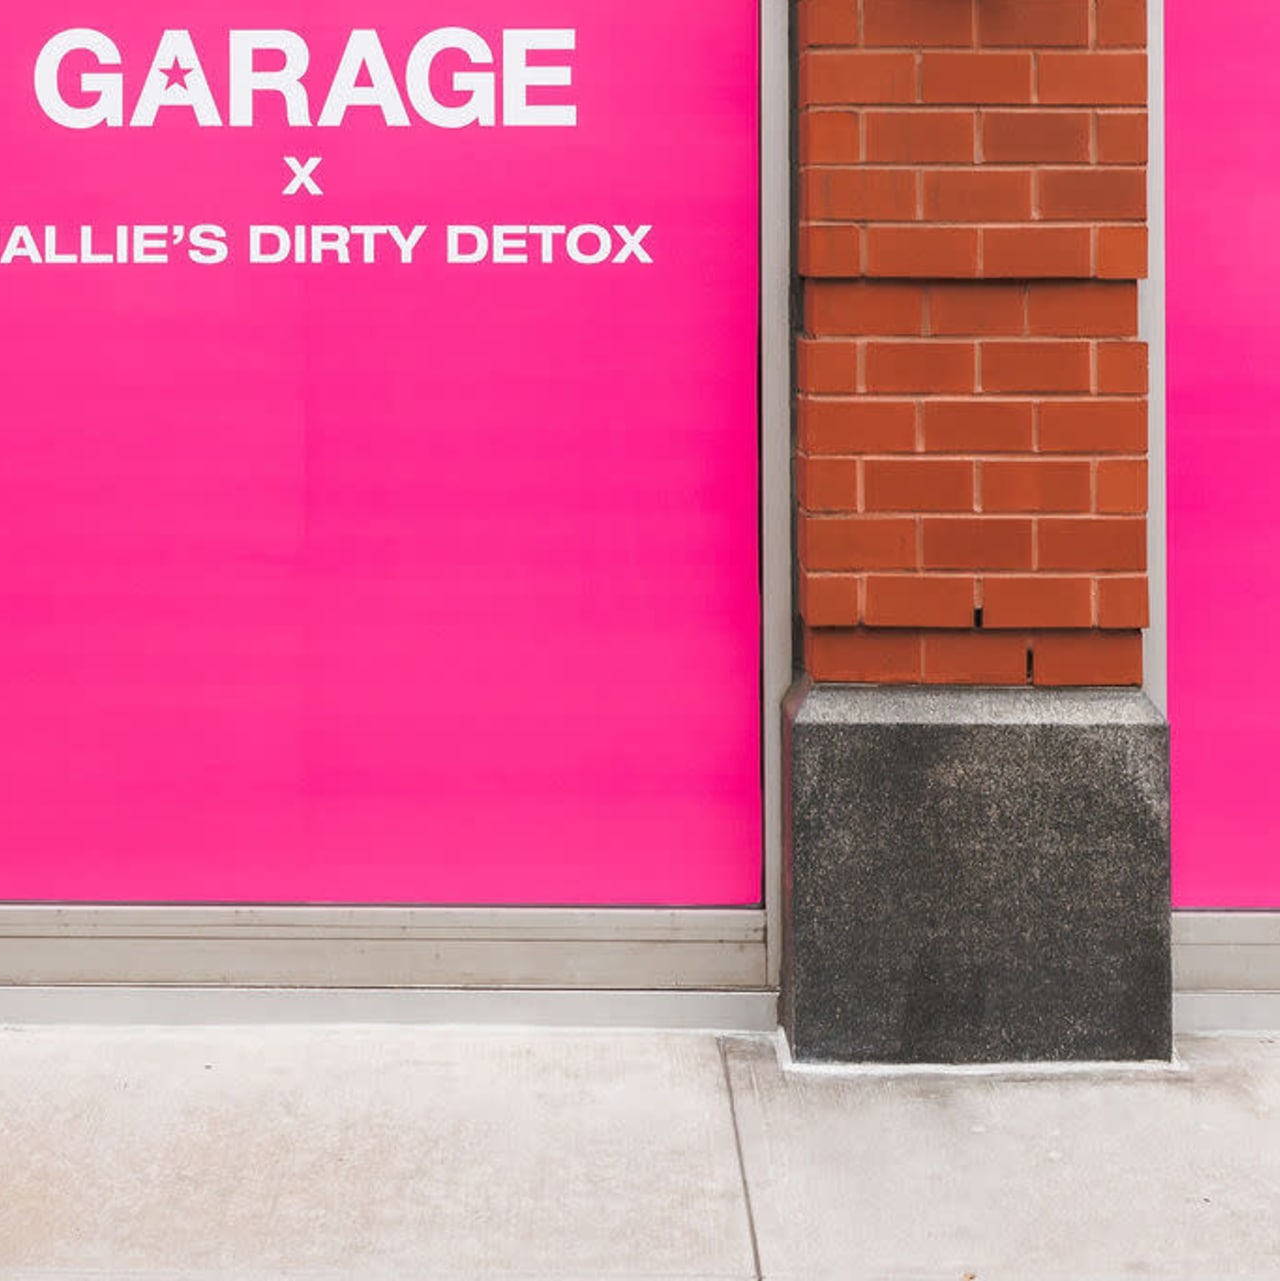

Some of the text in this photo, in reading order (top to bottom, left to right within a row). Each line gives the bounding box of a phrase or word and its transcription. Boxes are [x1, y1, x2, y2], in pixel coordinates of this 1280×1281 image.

[33, 26, 578, 130] GARAGE
[249, 224, 428, 264] DIRTY
[446, 223, 654, 265] DETOX
